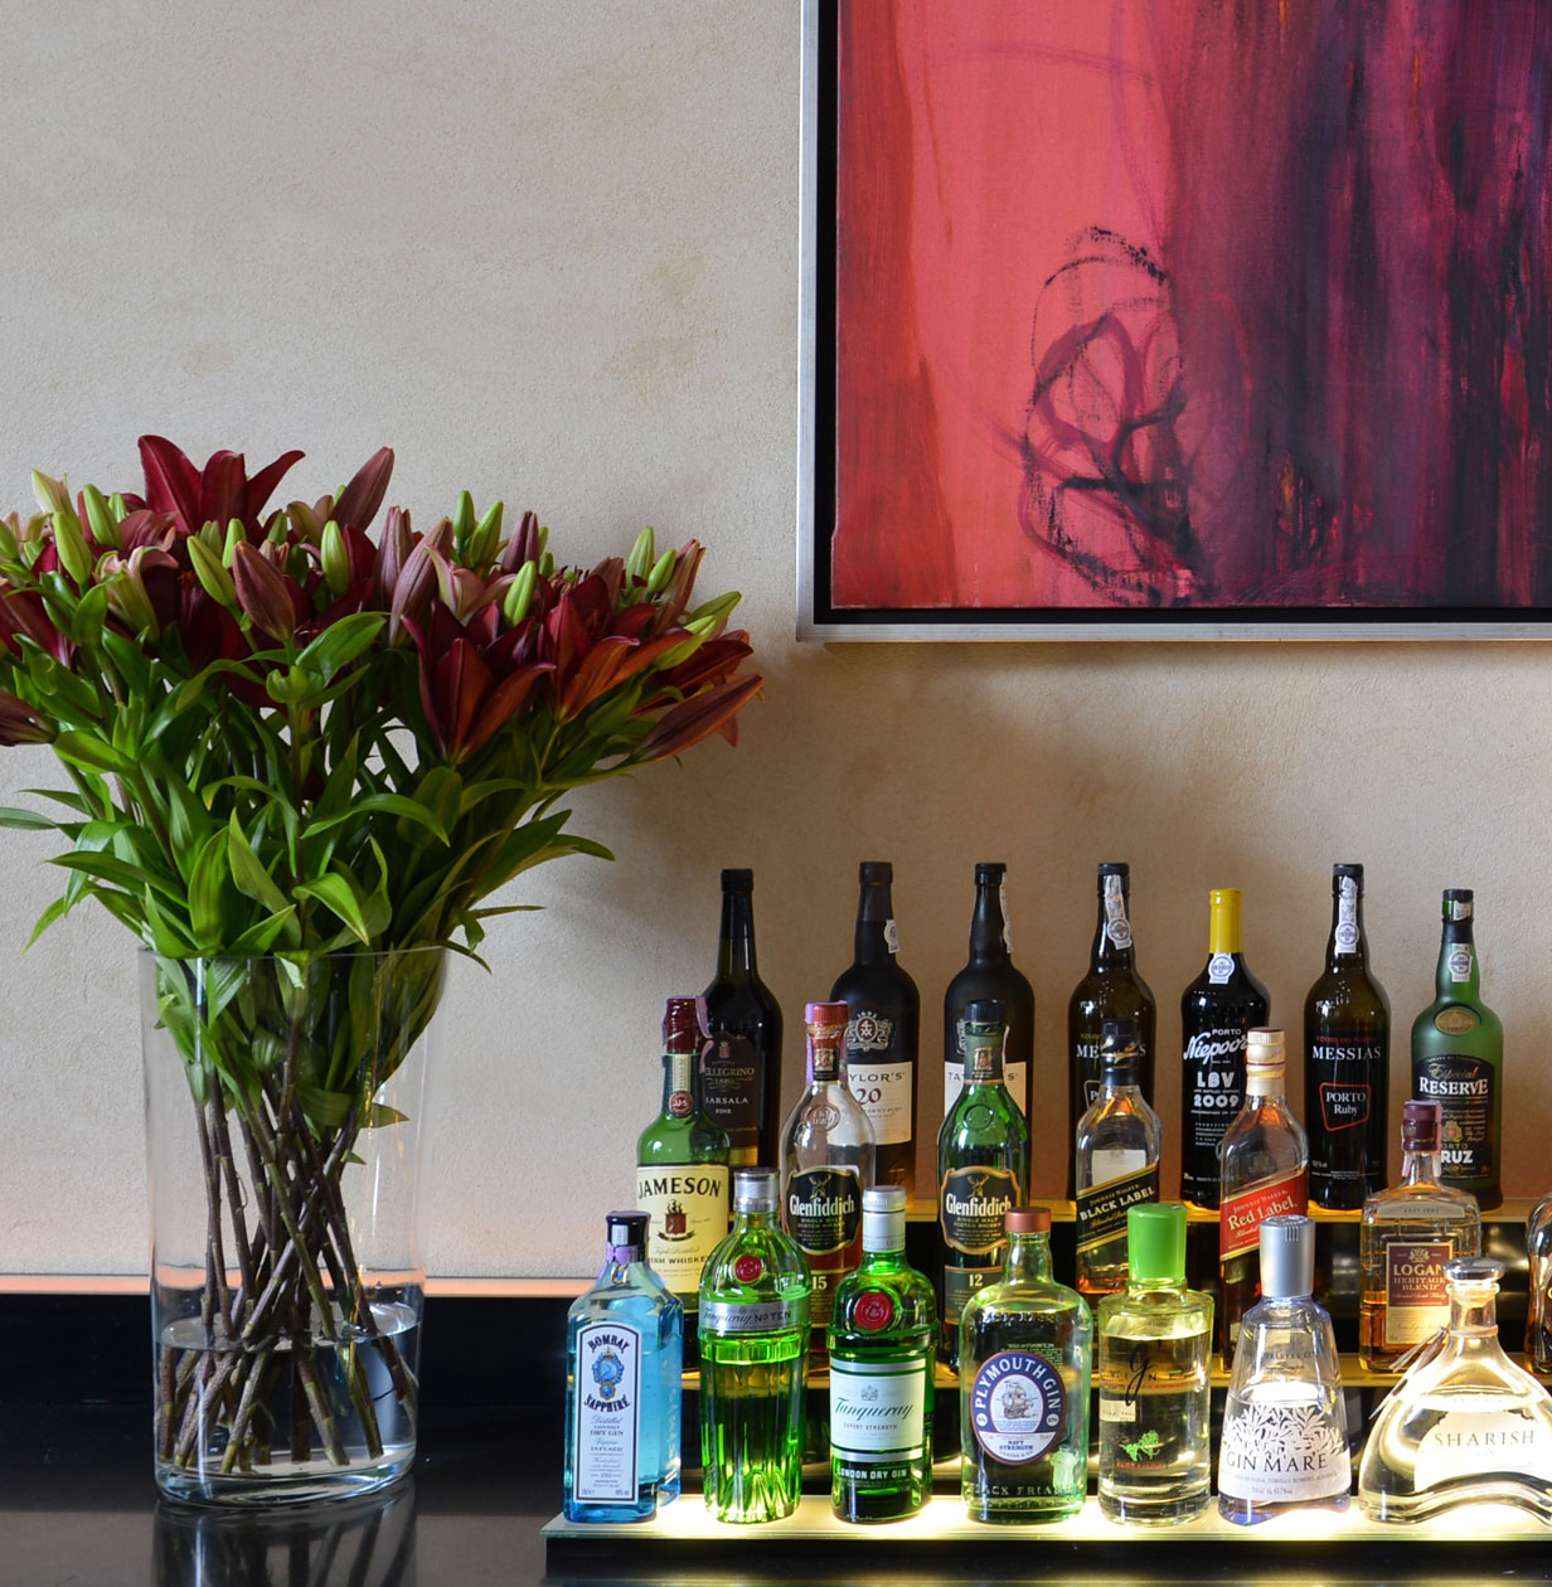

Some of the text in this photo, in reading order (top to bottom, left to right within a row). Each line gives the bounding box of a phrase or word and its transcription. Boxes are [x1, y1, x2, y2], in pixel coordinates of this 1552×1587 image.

[1212, 1028, 1241, 1036] PORTO
[1183, 1031, 1248, 1065] Niepoor
[1312, 1045, 1382, 1060] MESSIAS
[849, 1071, 904, 1083] YLOR'S
[1197, 1071, 1235, 1088] LBV
[1419, 1077, 1489, 1095] RESERVE
[856, 1087, 881, 1105] 20
[1193, 1094, 1239, 1108] 2009
[1326, 1091, 1366, 1102] PORTO
[1333, 1103, 1358, 1115] Ruby
[1441, 1150, 1474, 1163] RUZ
[639, 1177, 722, 1199] JAMESON
[790, 1194, 855, 1217] Glenfiddich
[945, 1193, 1012, 1217] Glenfiddich
[1080, 1200, 1117, 1221] BLACK
[1120, 1187, 1155, 1206] LABEL
[1228, 1194, 1294, 1231] Red Label
[811, 1273, 828, 1290] 15
[969, 1274, 983, 1287] 12
[587, 1334, 630, 1354] BOMBAY
[974, 1357, 1061, 1409] PLYMOUTH GIN
[584, 1394, 630, 1412] SAPPHIRE
[834, 1396, 914, 1420] Tanqueray
[1435, 1430, 1534, 1448] SHARISH
[1226, 1451, 1329, 1472] GIN MARE
[869, 1470, 889, 1480] DRY
[891, 1469, 908, 1478] GIN
